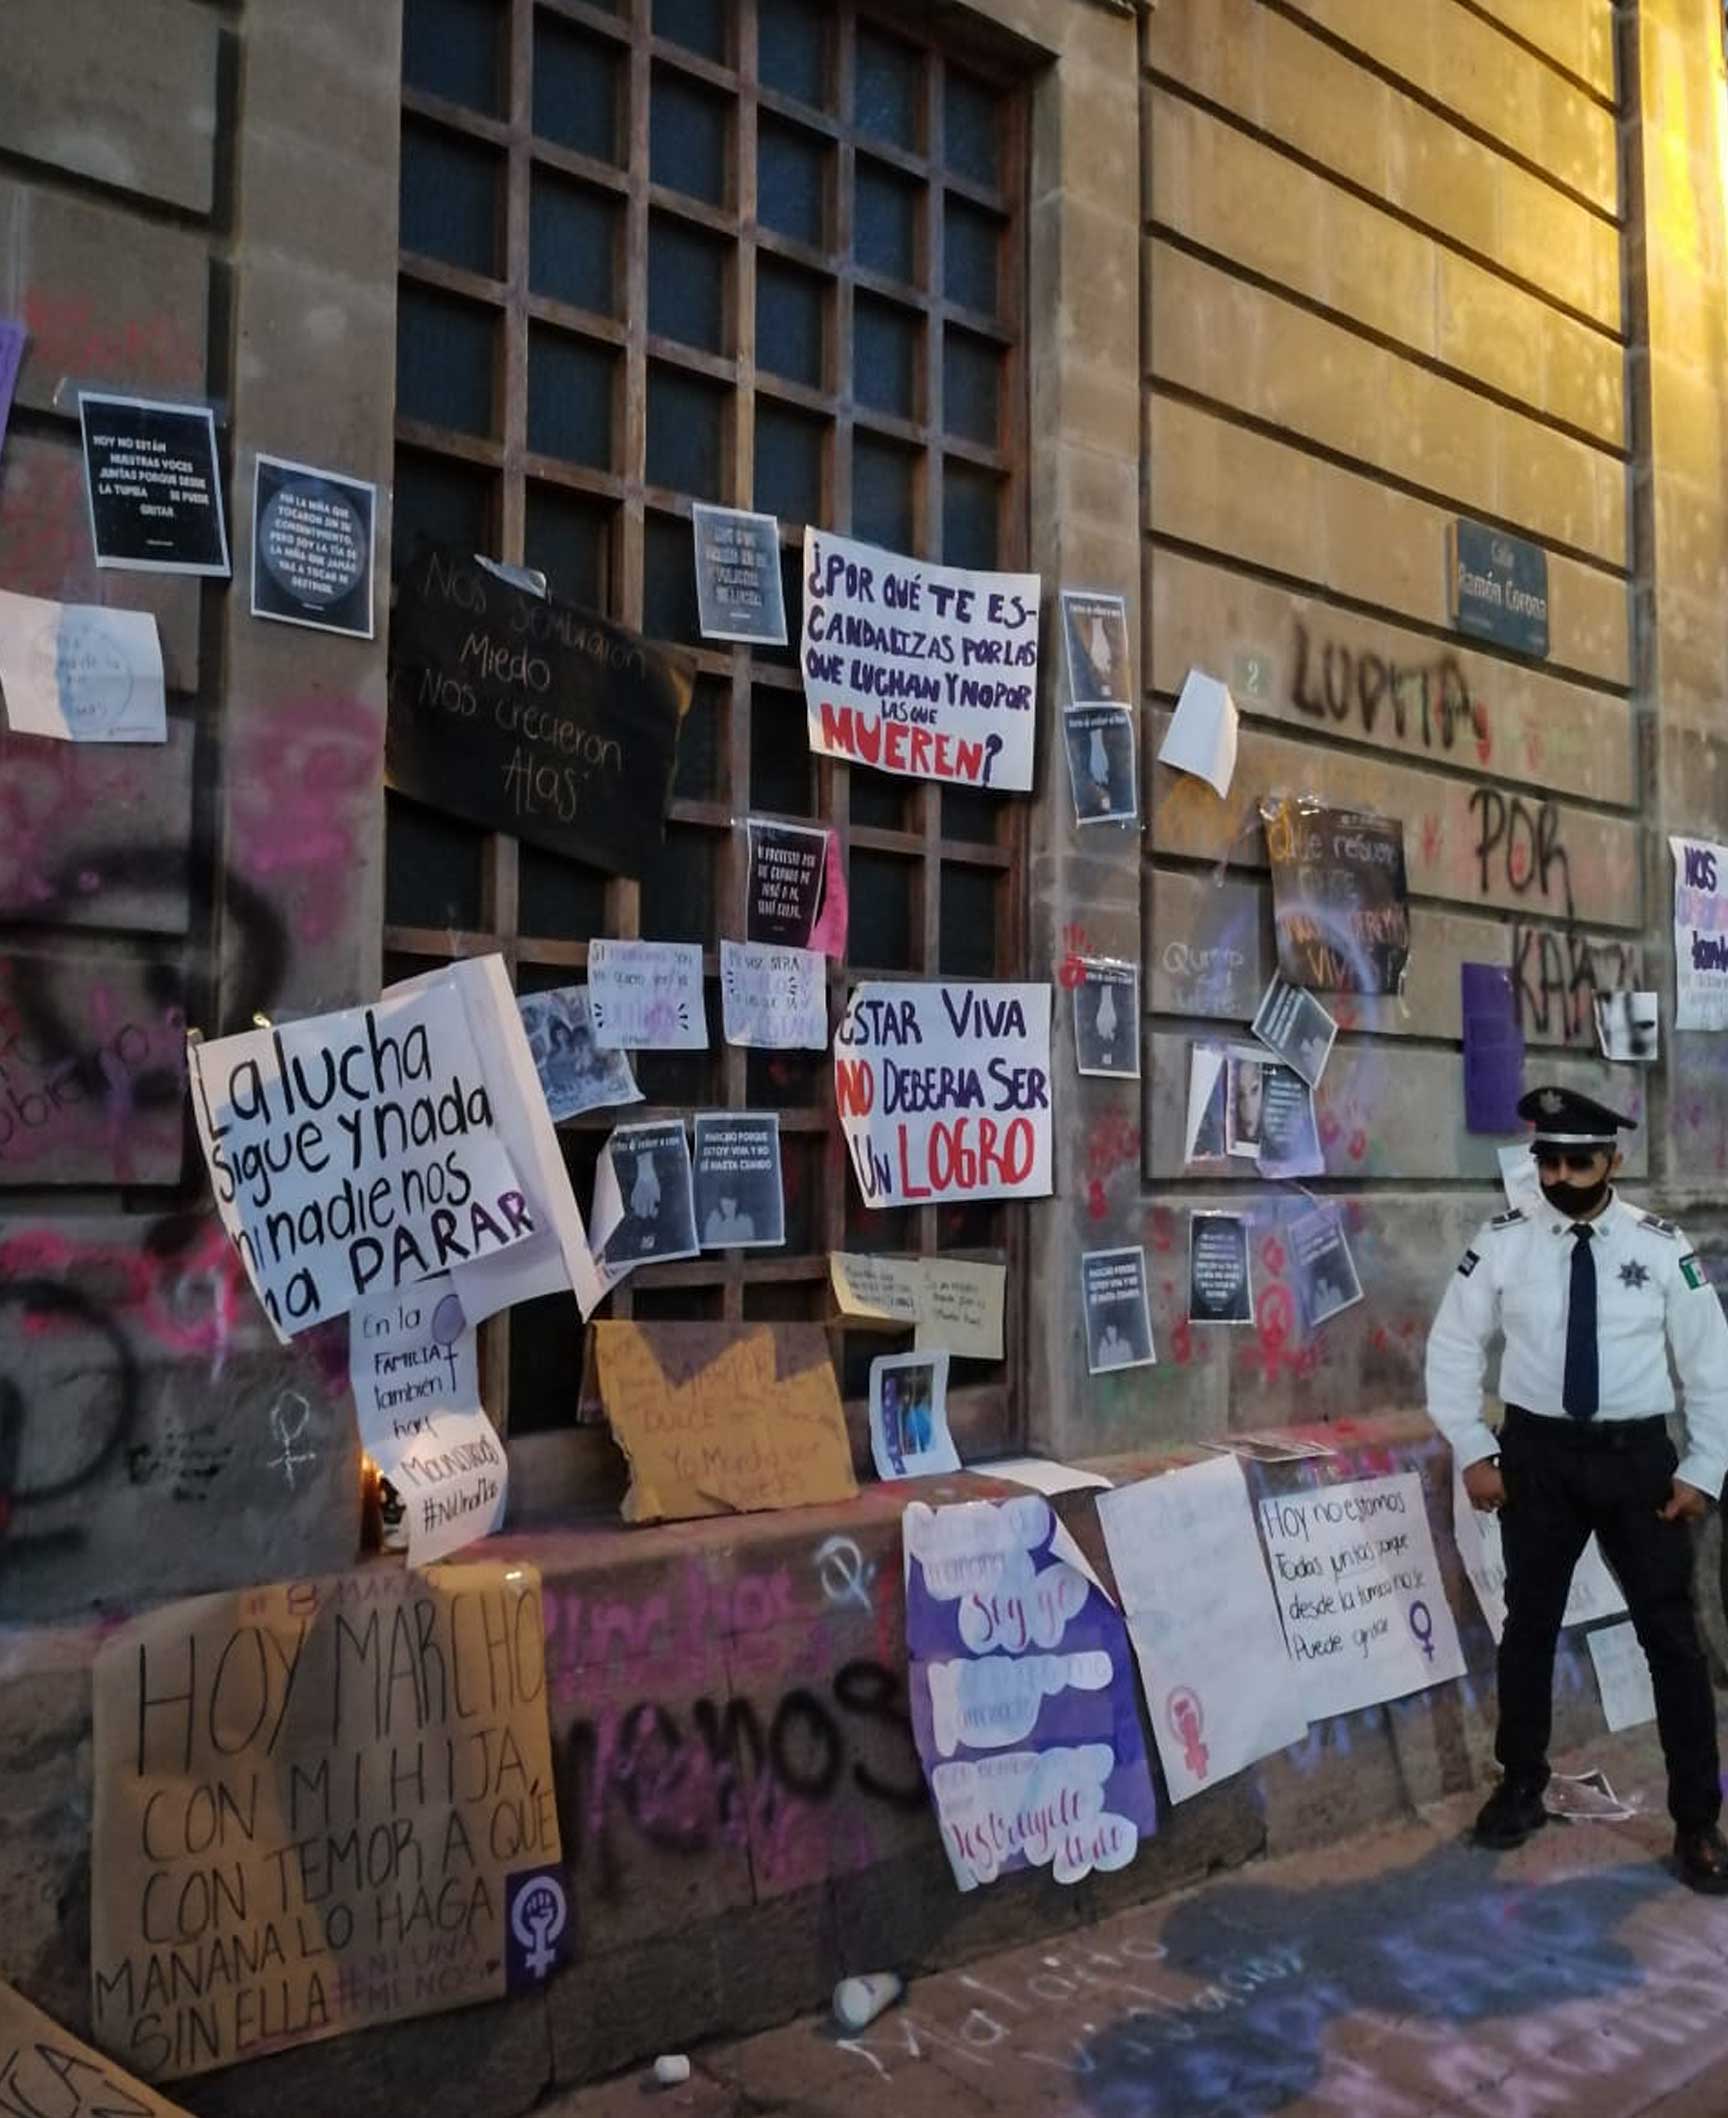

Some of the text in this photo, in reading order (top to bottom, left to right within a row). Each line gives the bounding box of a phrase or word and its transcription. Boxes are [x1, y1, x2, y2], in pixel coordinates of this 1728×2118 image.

[98, 483, 112, 495] LA
[161, 459, 193, 473] VOCES
[808, 542, 875, 603] ¿POR
[883, 574, 922, 612] QUÉ
[928, 584, 976, 623] TE
[987, 593, 1038, 629] ES-
[418, 667, 477, 717] Nos
[459, 632, 551, 693] Miedo
[806, 648, 1033, 711] QUE LUCHAN Y NO POR
[962, 638, 1002, 667] POR
[1003, 641, 1037, 668] LAS
[1292, 617, 1490, 749] LUPITA
[881, 699, 937, 724] LAS QUE
[1469, 787, 1573, 910] POR
[1684, 846, 1717, 892] NOS
[373, 1076, 494, 1159] nada
[837, 1057, 1049, 1118] NO DEBERIA SER
[853, 1117, 1036, 1199] UN LOGRO
[265, 1178, 396, 1264] nadie
[348, 1191, 536, 1295] PARAR
[399, 1306, 421, 1332] la
[1288, 1593, 1336, 1622] desde
[137, 1621, 310, 1777] HOY
[332, 1588, 545, 1748] MARCHO
[142, 1773, 259, 1864] CON
[290, 1750, 363, 1834] MI
[141, 1789, 556, 1946] CON TEMOR A QUE
[296, 1903, 356, 1961] LO
[375, 1874, 495, 1942] HAGA
[128, 1971, 332, 2078] SIN ELLA
